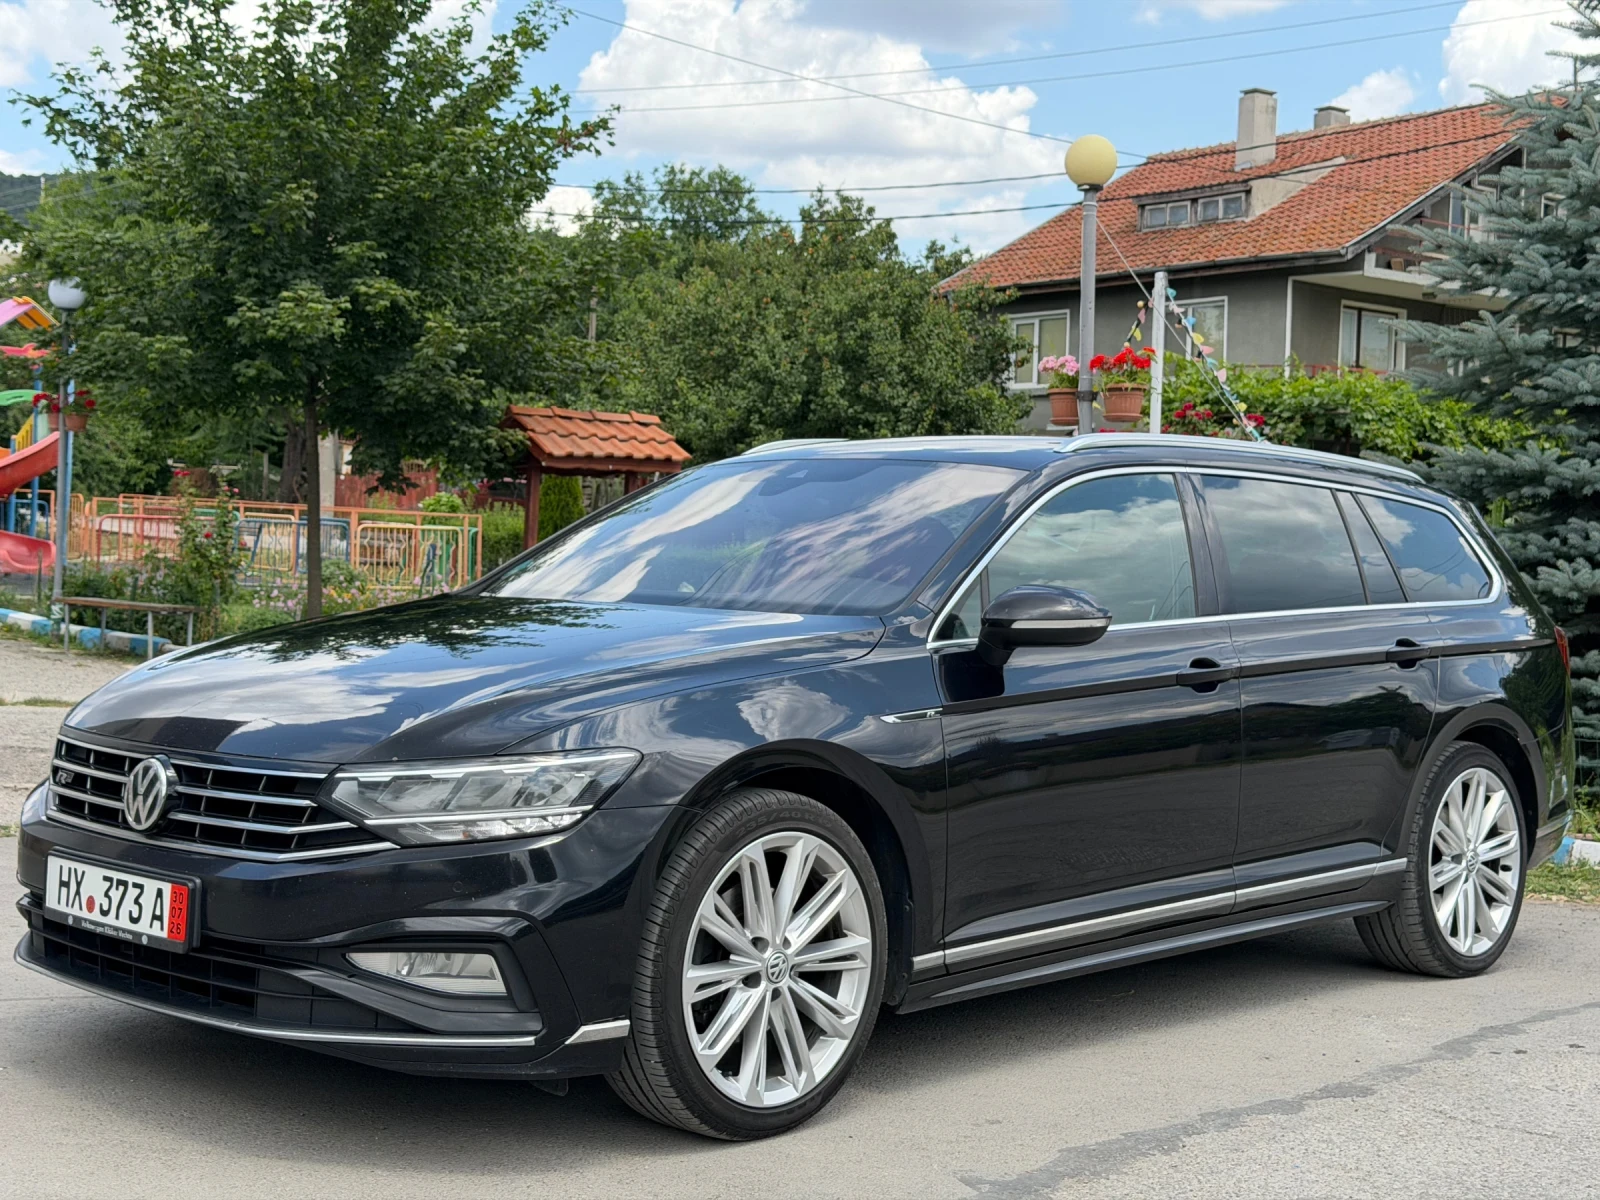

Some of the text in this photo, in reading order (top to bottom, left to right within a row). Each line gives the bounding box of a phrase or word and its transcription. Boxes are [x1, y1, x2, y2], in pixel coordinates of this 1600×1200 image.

[57, 864, 164, 932] HX 373 A
[173, 891, 184, 904] 30
[171, 906, 183, 919] 07
[169, 921, 182, 935] 26
